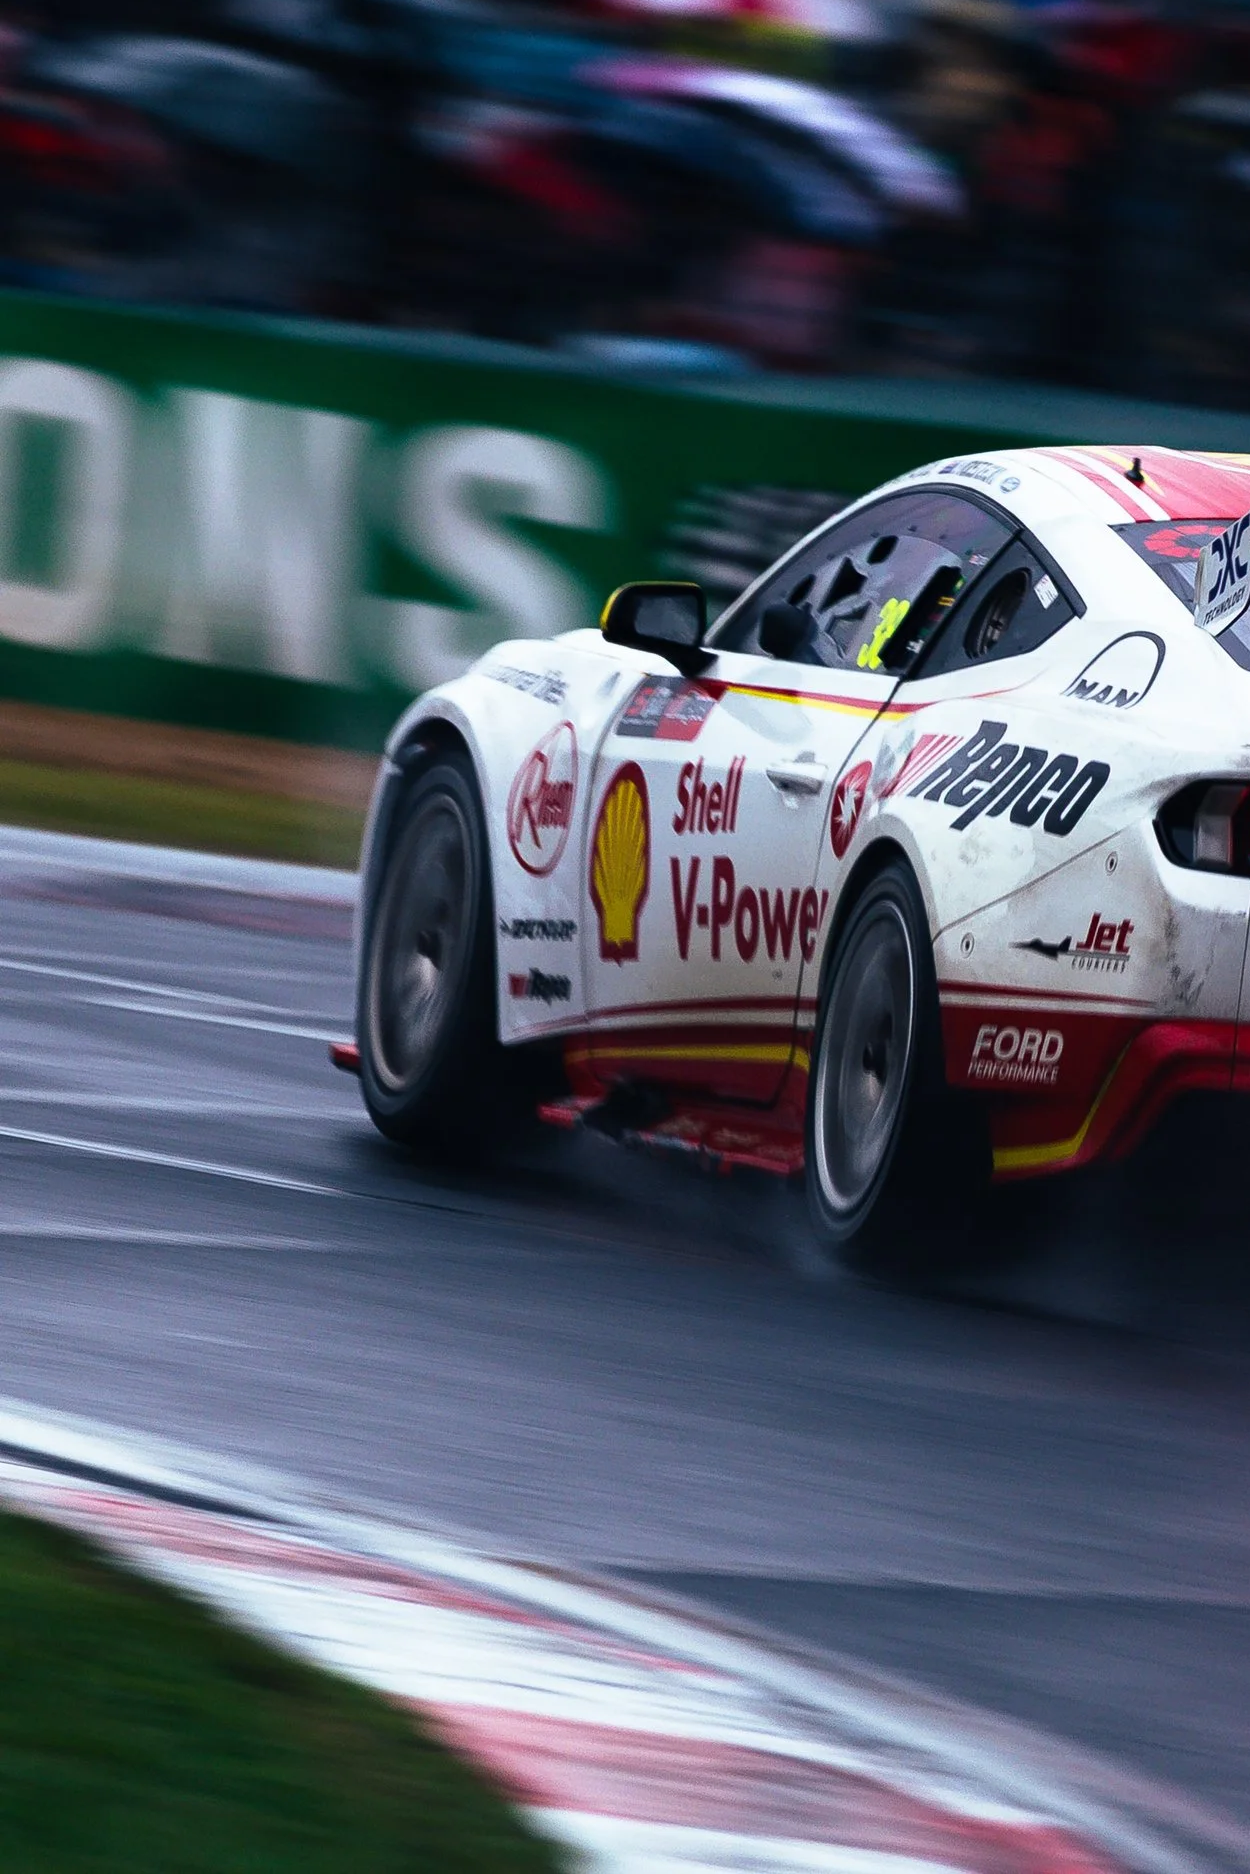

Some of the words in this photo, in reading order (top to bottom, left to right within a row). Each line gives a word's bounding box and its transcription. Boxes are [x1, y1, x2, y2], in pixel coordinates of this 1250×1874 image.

[1207, 512, 1250, 605] DXC
[1066, 678, 1140, 710] MAN
[672, 755, 747, 836] Shell
[1076, 911, 1135, 954] Jet
[1071, 956, 1127, 974] COURIERS
[972, 1024, 1065, 1064] FORD
[967, 1058, 1060, 1086] PERFORMANCE
